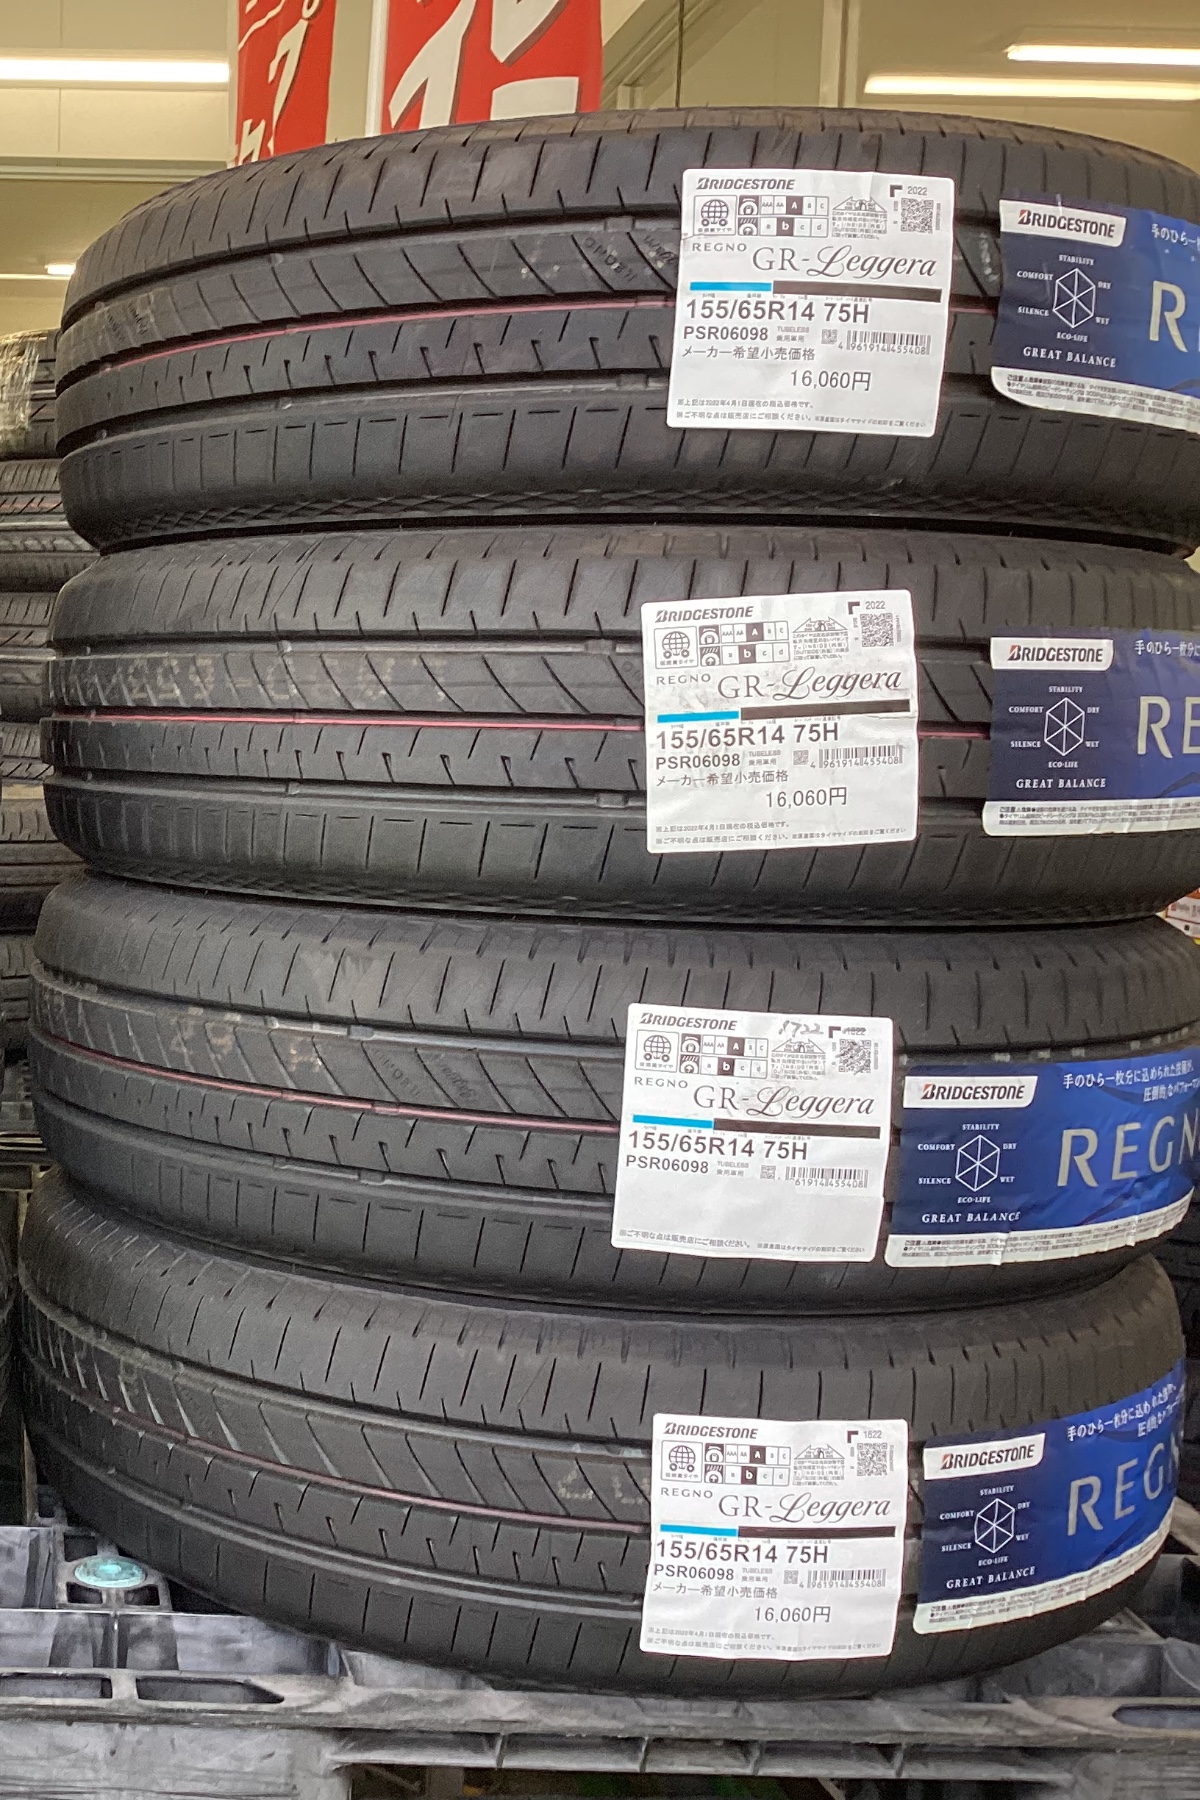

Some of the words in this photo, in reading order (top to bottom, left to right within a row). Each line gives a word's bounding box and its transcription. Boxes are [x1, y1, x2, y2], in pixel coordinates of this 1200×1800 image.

[696, 178, 795, 190] BRIDGESTONE
[908, 186, 927, 195] 2022
[782, 222, 789, 230] b
[1018, 210, 1115, 238] BRIDGESTONE
[1151, 224, 1200, 247] 手のひら一
[693, 243, 746, 251] REGNO
[753, 245, 937, 279] GR-Leggera
[686, 300, 815, 322] 155/65R14
[824, 303, 869, 323] 75H
[683, 326, 768, 341] PSR06098
[682, 346, 815, 360] メーカー希望小売価格
[1023, 347, 1062, 360] GREAT
[1067, 352, 1116, 367] BALANCE
[791, 371, 870, 391] 16,060円
[866, 601, 885, 610] 2022
[655, 606, 754, 623] BRIDGESTONE
[743, 649, 750, 657] b
[1008, 645, 1103, 662] BRIDGESTONE
[657, 674, 711, 685] REGNO
[718, 667, 901, 701] GR-Leggera
[657, 728, 784, 749] 155/65R14
[794, 723, 838, 742] 75H
[656, 755, 740, 769] PSR06098
[657, 771, 789, 786] メーカー希望小売価格
[1016, 779, 1053, 788] GREAT
[1058, 778, 1106, 787] BALANCE
[766, 787, 847, 809] 16,060円
[640, 1013, 737, 1031] BRIDGESTONE
[723, 1062, 730, 1070] b
[635, 1077, 688, 1088] REGNO
[694, 1085, 875, 1117] GR-Leggera
[921, 1084, 1025, 1100] BRIDGESTONE
[629, 1131, 754, 1157] 155/65R14
[764, 1140, 807, 1160] 75H
[1057, 1107, 1200, 1187] REGN
[626, 1155, 709, 1173] PSR06098
[922, 1214, 962, 1223] GREAT
[967, 1212, 1021, 1222] BALANCE
[664, 1422, 758, 1439] BRIDGESTONE
[755, 1451, 760, 1459] A
[941, 1444, 1035, 1470] BRIDGESTONE
[746, 1471, 753, 1479] b
[661, 1487, 713, 1498] REGNO
[719, 1493, 890, 1523] GR-Leggera
[940, 1510, 974, 1520] COMFORT
[656, 1539, 777, 1563] 155/65R14
[786, 1546, 828, 1564] 75H
[942, 1543, 971, 1552] SILENCE
[654, 1564, 734, 1580] PSR06098
[946, 1576, 983, 1589] GREAT
[988, 1567, 1035, 1583] BALANCE
[653, 1584, 777, 1599] メーカー希望小売価格
[755, 1606, 830, 1623] 16,060円
